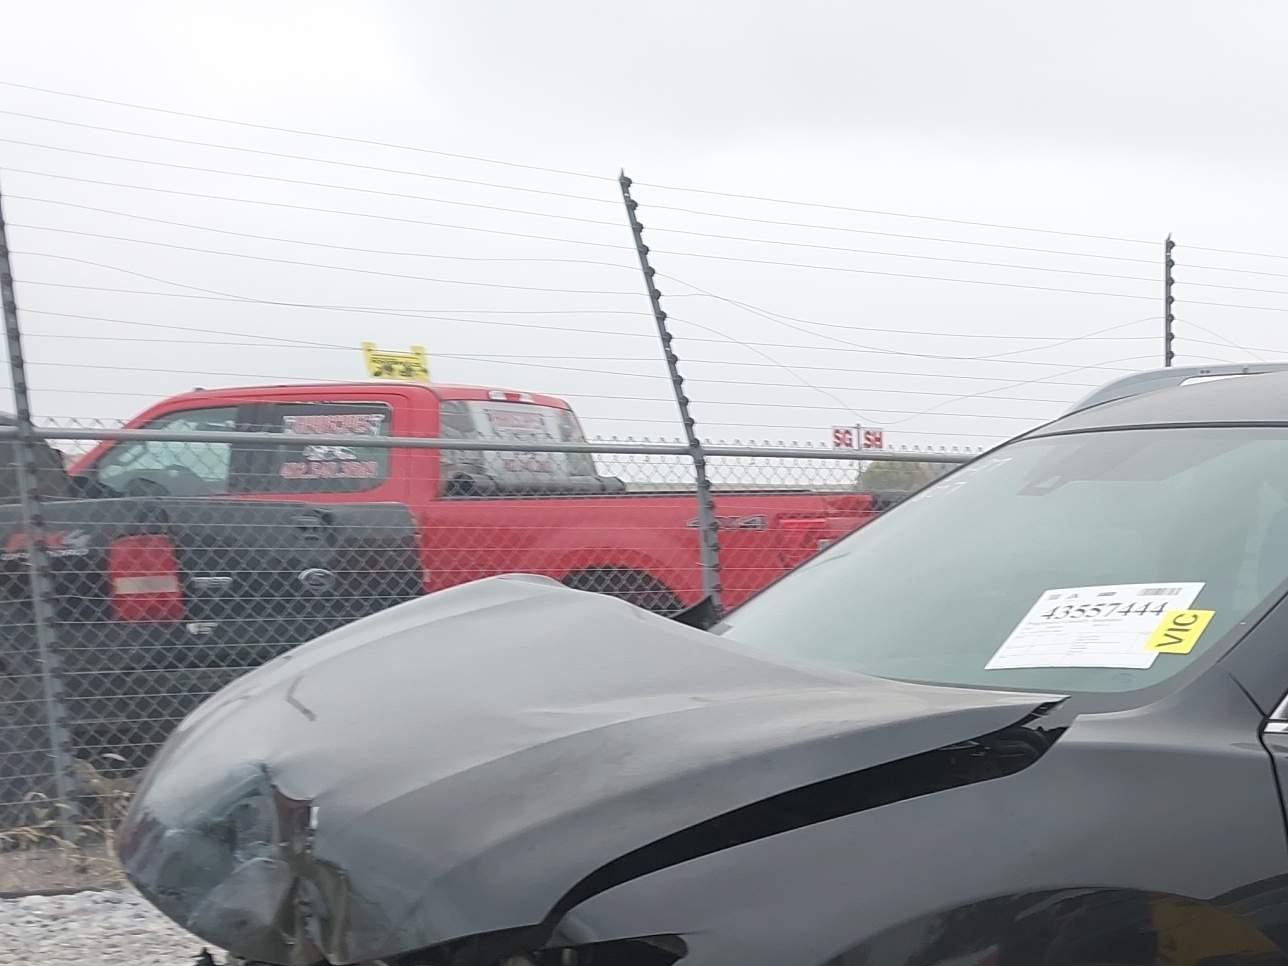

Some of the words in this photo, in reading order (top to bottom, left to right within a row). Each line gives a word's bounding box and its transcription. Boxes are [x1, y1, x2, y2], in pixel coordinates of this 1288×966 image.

[833, 429, 853, 448] SG
[1041, 601, 1168, 620] 43557444
[1155, 612, 1199, 648] VIC
